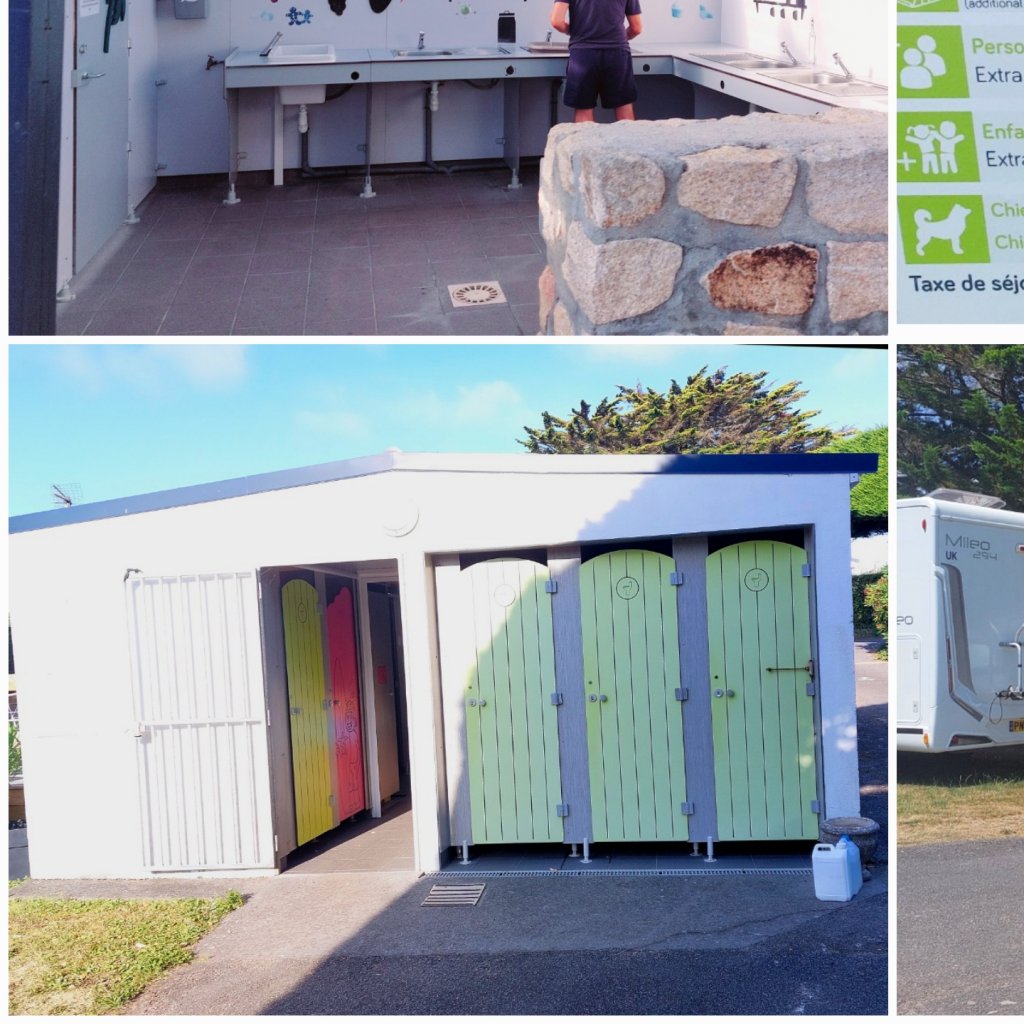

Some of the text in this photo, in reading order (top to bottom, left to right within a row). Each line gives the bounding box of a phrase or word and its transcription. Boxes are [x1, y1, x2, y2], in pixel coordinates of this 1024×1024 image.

[976, 66, 1022, 82] Extra
[945, 533, 990, 551] Mileo
[945, 550, 958, 561] UK
[972, 551, 998, 561] 294
